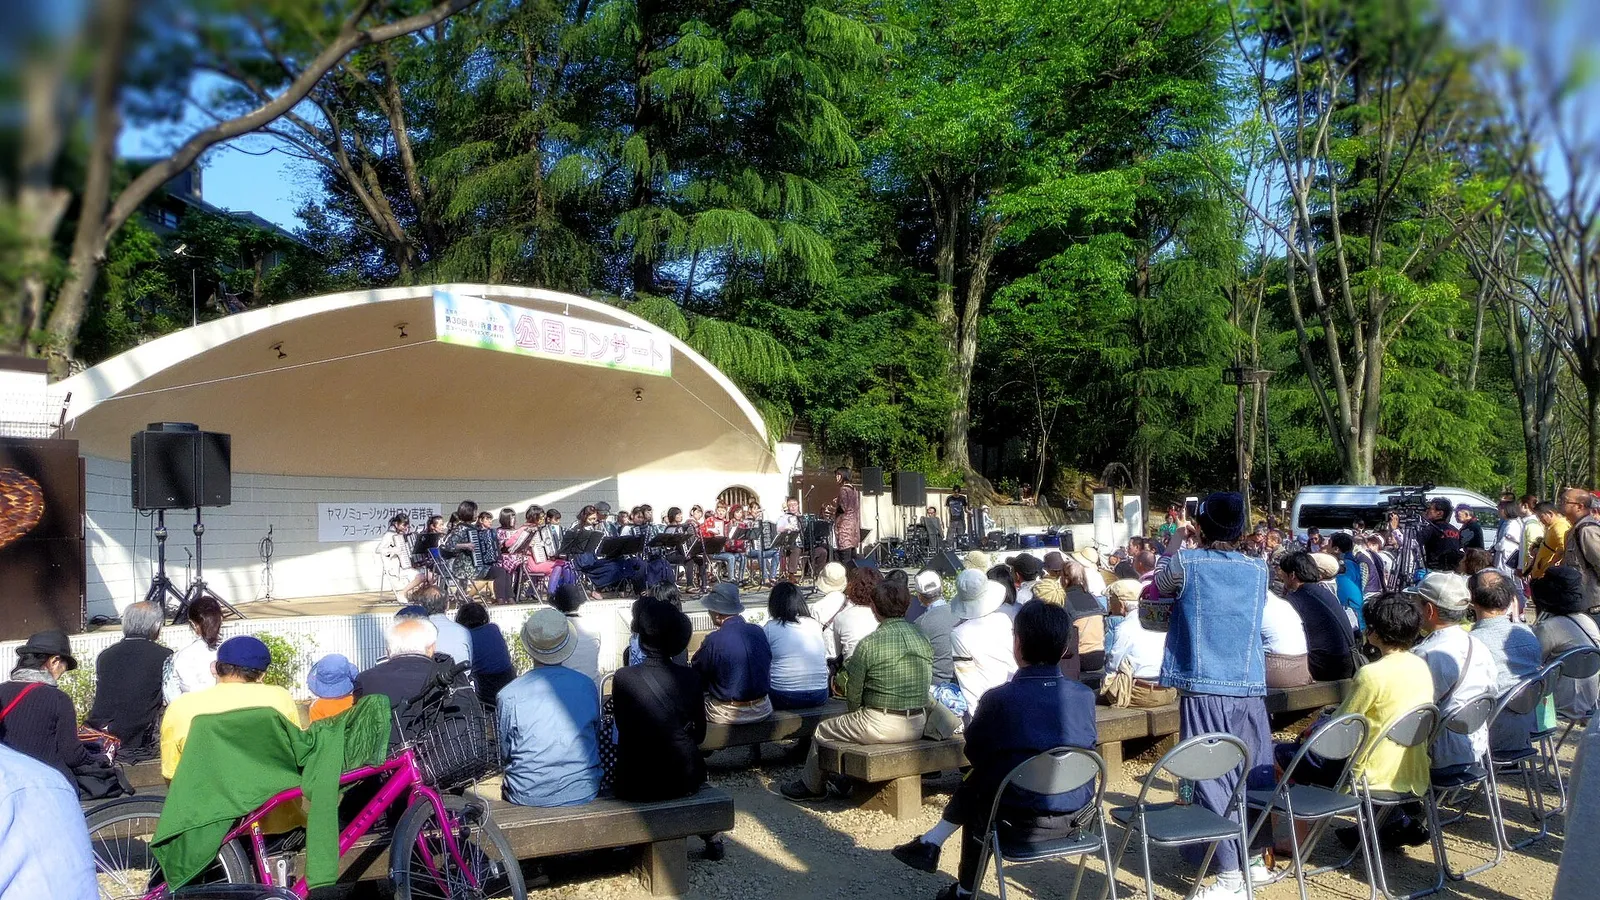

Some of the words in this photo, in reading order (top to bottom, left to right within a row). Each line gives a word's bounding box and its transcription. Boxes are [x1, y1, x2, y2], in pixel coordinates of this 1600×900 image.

[514, 314, 663, 367] 公園コンサート
